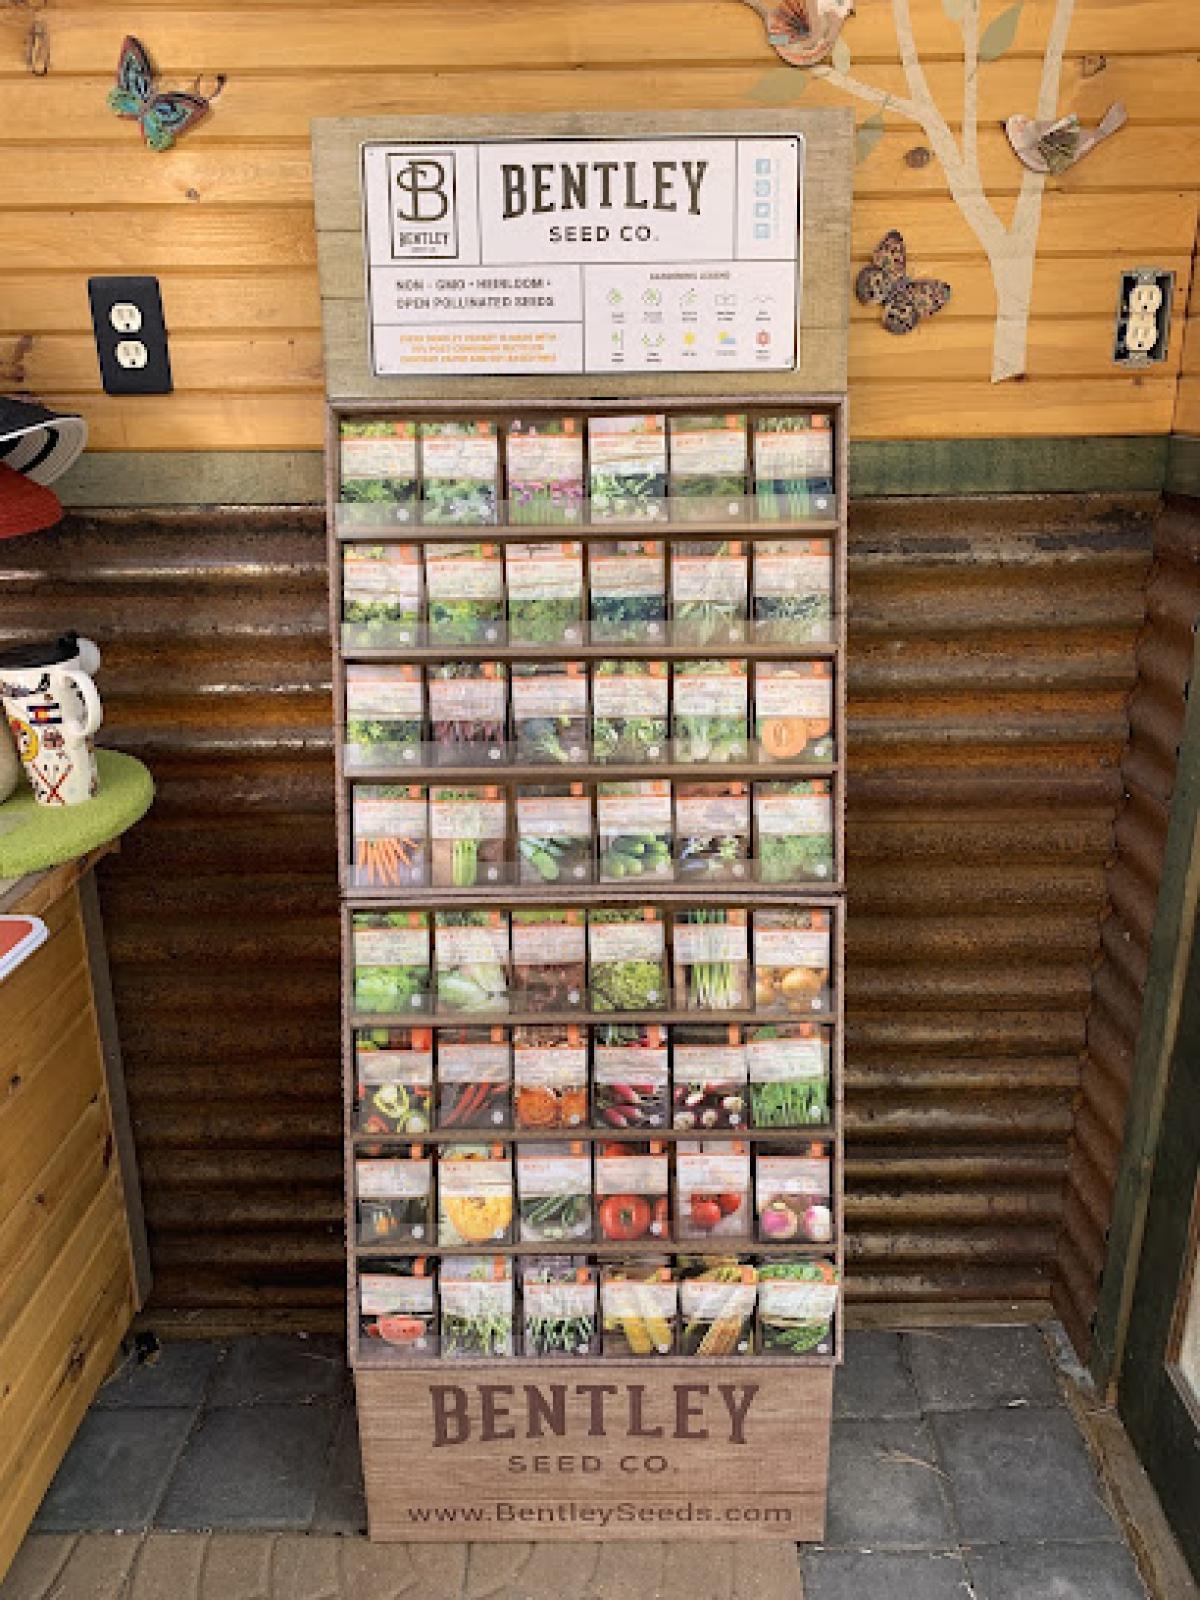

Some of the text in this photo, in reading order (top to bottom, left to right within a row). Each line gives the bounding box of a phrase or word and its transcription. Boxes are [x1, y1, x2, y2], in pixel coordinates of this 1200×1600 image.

[500, 160, 709, 220] BENTLEY
[549, 225, 660, 242] SEED CO.
[429, 1384, 760, 1448] BENTLEY
[508, 1455, 680, 1474] SEED CO.
[407, 1502, 793, 1527] www.BentleySeeds.com
